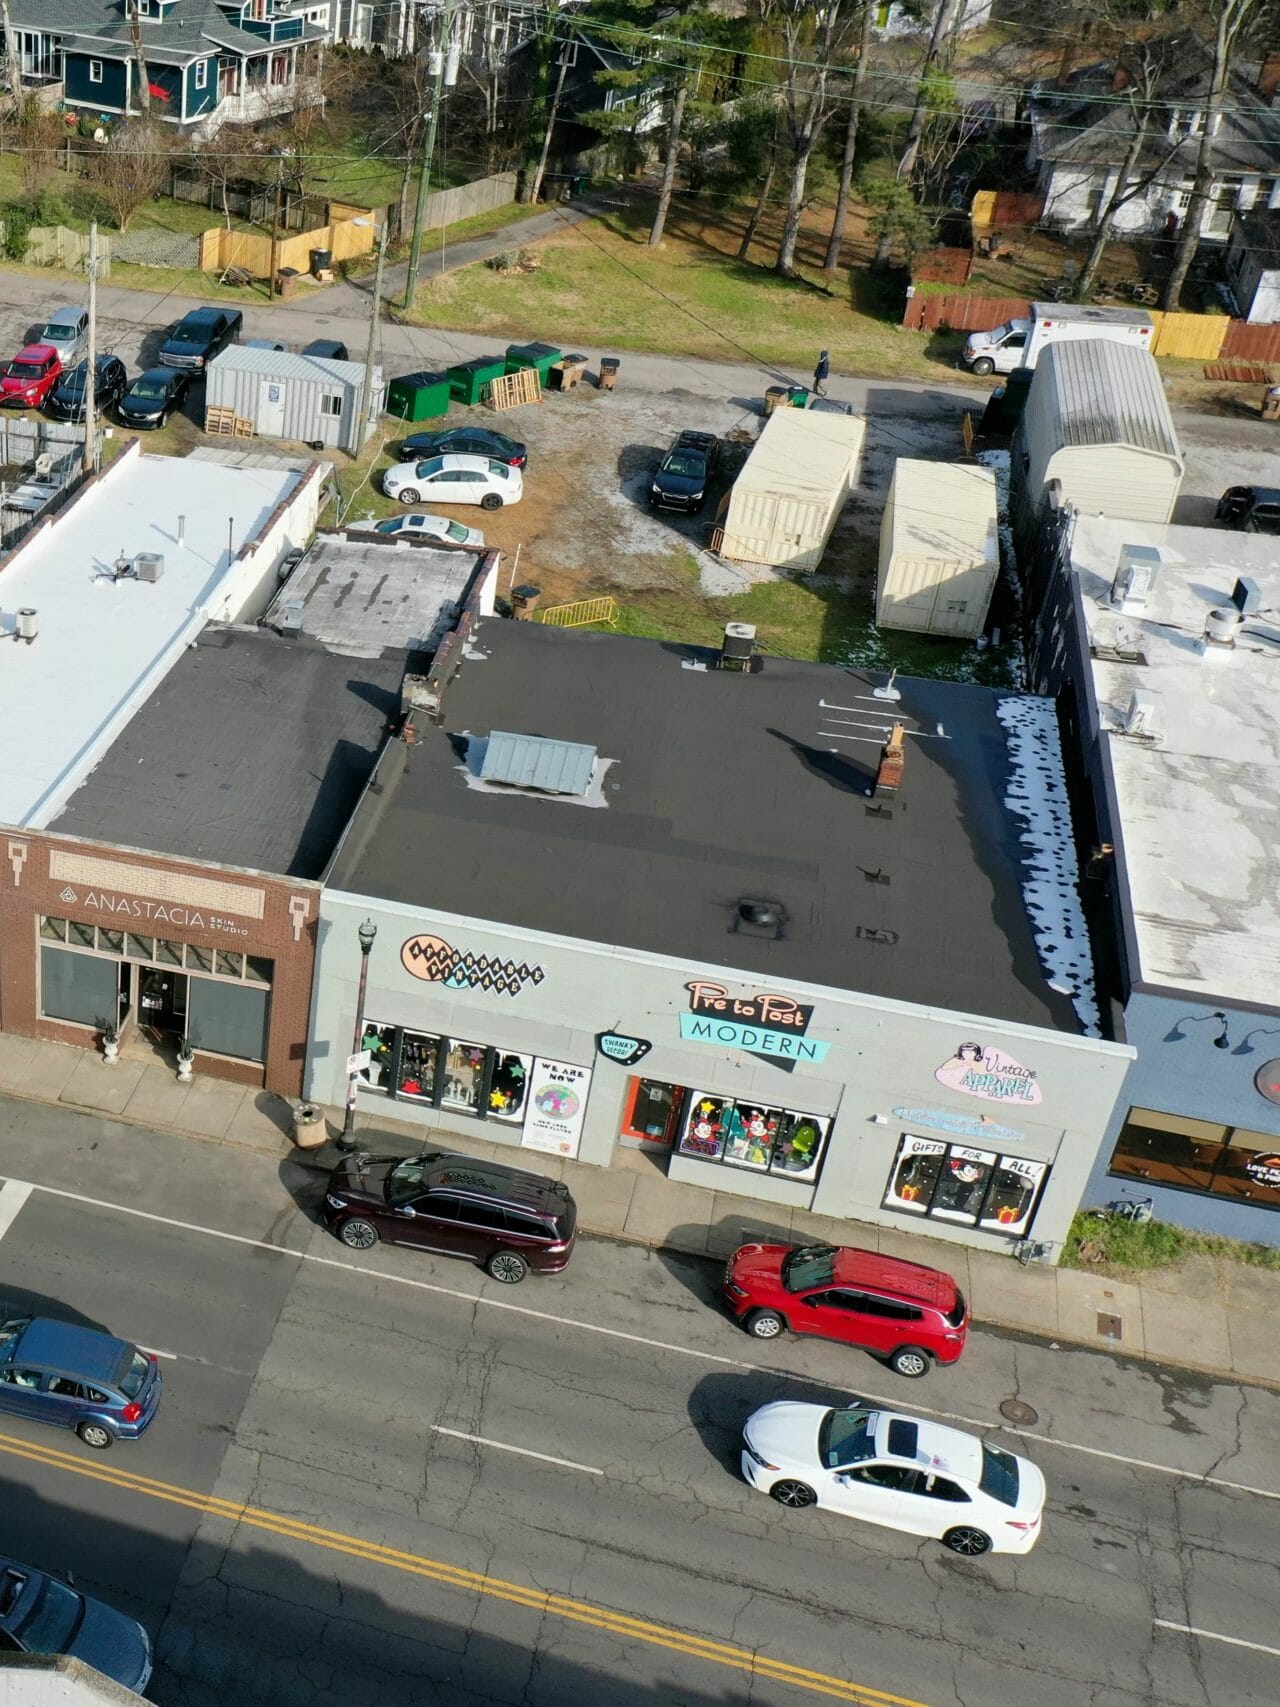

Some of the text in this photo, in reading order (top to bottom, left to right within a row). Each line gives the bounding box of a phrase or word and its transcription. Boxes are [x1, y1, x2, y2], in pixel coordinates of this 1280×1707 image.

[84, 892, 205, 929] ANASTACIA
[210, 916, 235, 926] SKIN
[209, 924, 249, 936] STUDIO
[412, 944, 542, 981] AFFORDABLE
[431, 964, 519, 993] VINTAGE
[688, 981, 805, 1027] Pre to Post
[604, 1038, 637, 1050] SWANKY
[691, 1020, 817, 1059] MODERN
[542, 1063, 585, 1079] WE ARE
[549, 1074, 576, 1084] NOW
[985, 1053, 1037, 1079] Vintage
[959, 1068, 1034, 1101] APPAREL
[912, 1141, 1044, 1178] GIFTS FOR ALL!
[1246, 1163, 1269, 1174] LOVE
